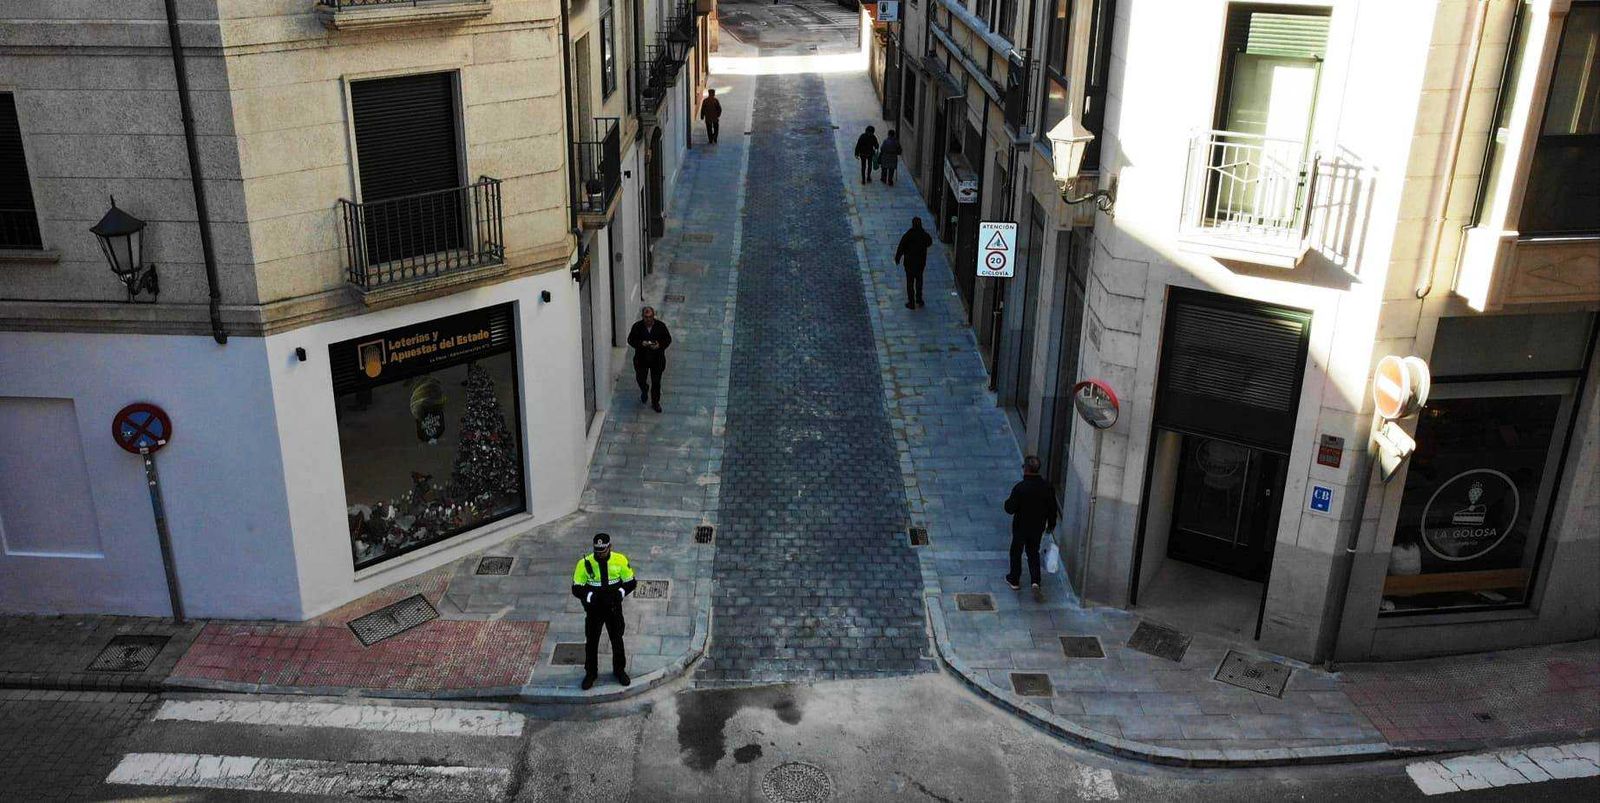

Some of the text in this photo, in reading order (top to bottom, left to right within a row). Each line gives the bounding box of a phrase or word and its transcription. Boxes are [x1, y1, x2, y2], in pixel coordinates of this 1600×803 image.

[432, 331, 439, 342] y
[390, 343, 437, 362] Apuestas
[440, 337, 455, 349] del
[456, 330, 490, 345] Estado
[1314, 488, 1330, 501] CB
[1434, 528, 1497, 539] LA GOLOSA
